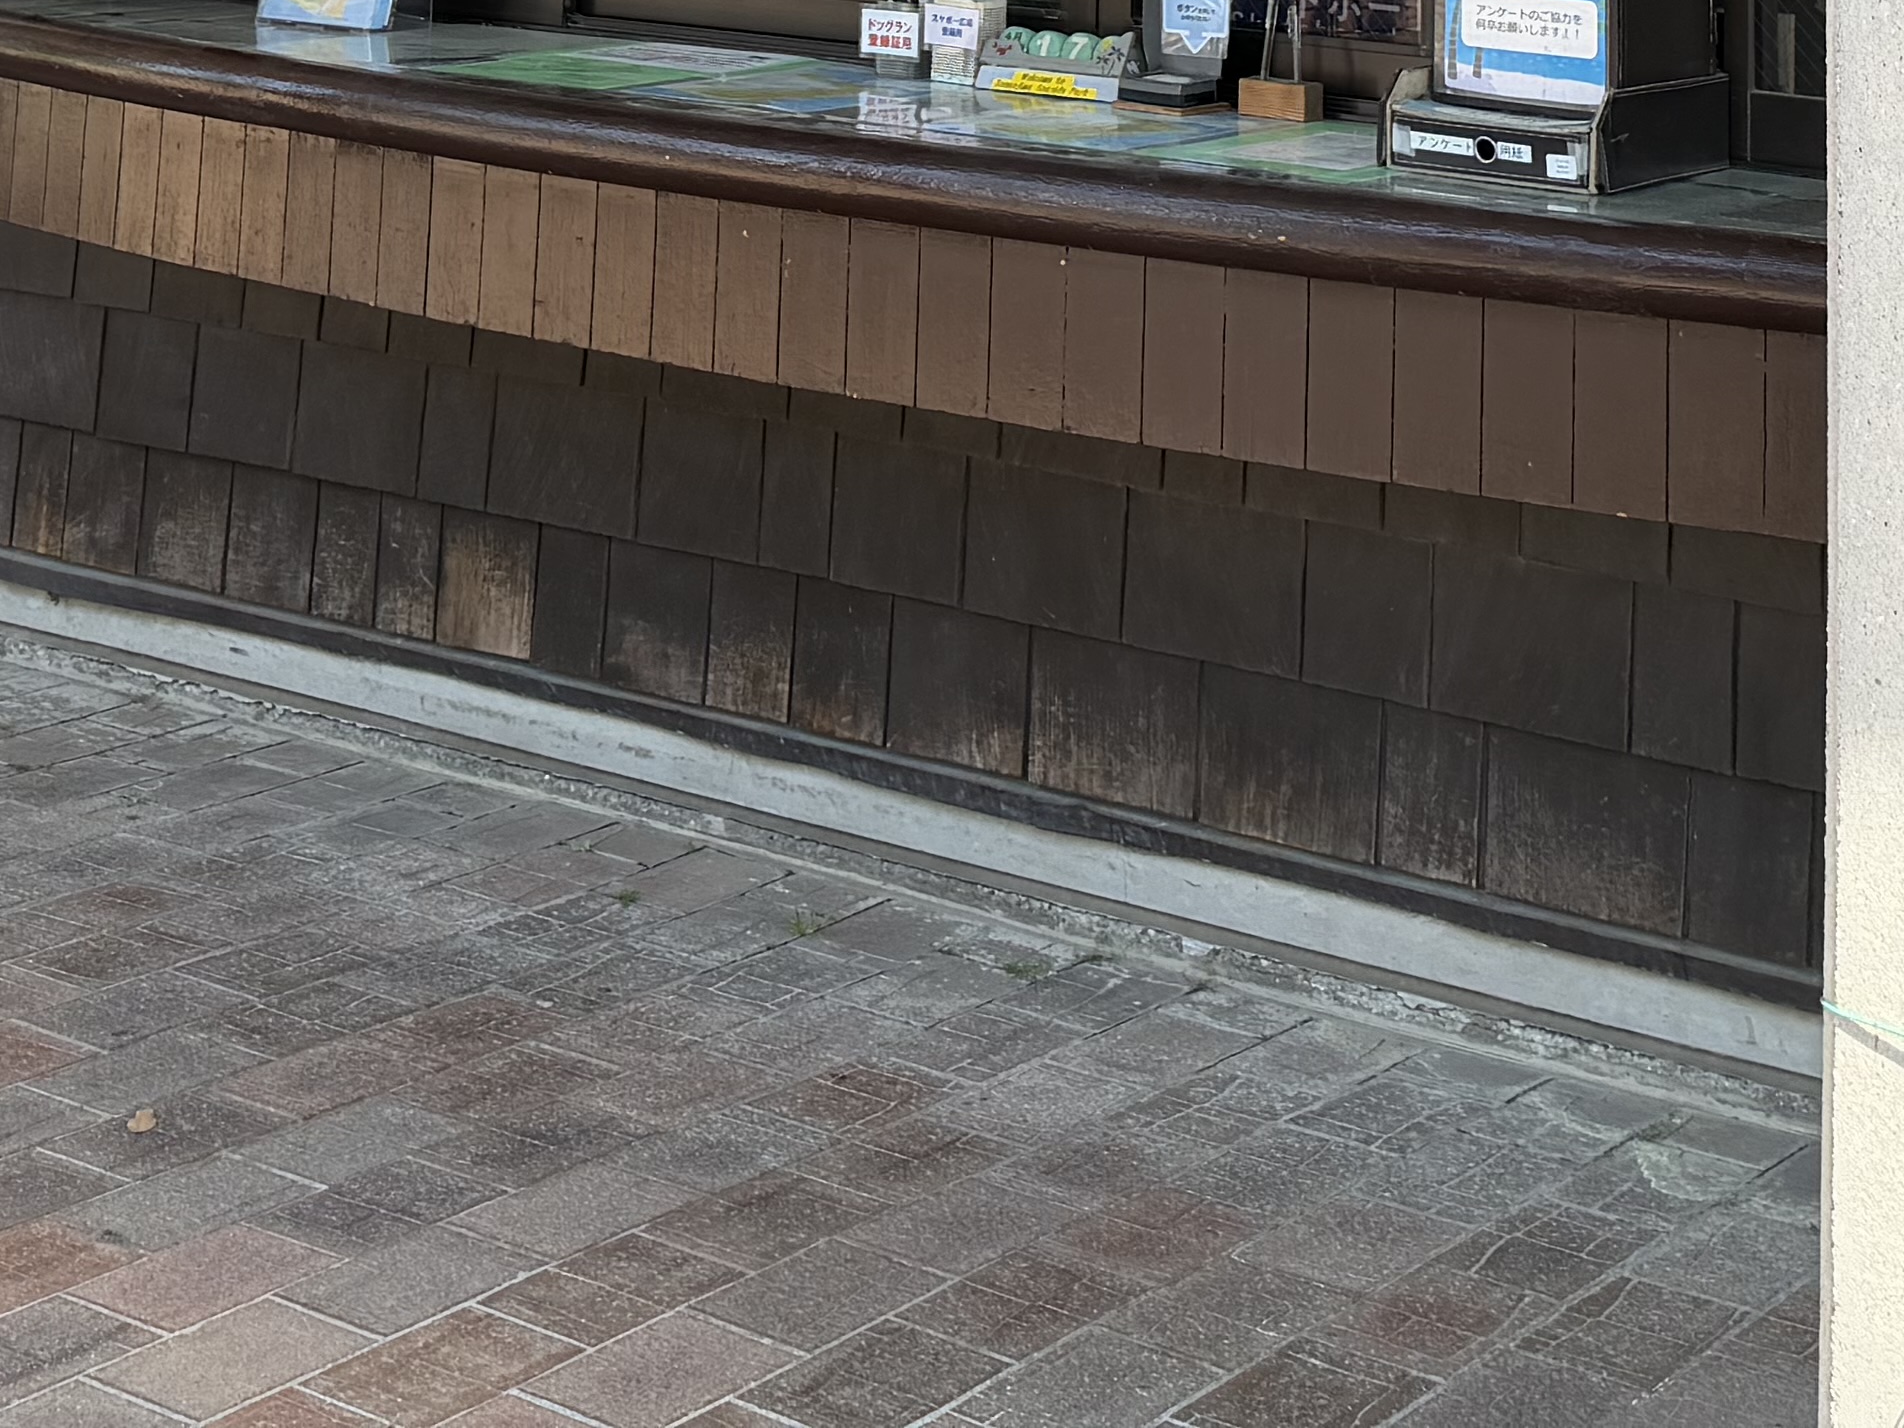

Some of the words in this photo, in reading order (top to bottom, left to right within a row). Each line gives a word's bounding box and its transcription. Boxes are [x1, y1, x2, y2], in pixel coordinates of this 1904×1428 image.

[1476, 3, 1583, 25] アンケートのご協力を
[1417, 134, 1472, 153] アンケート
